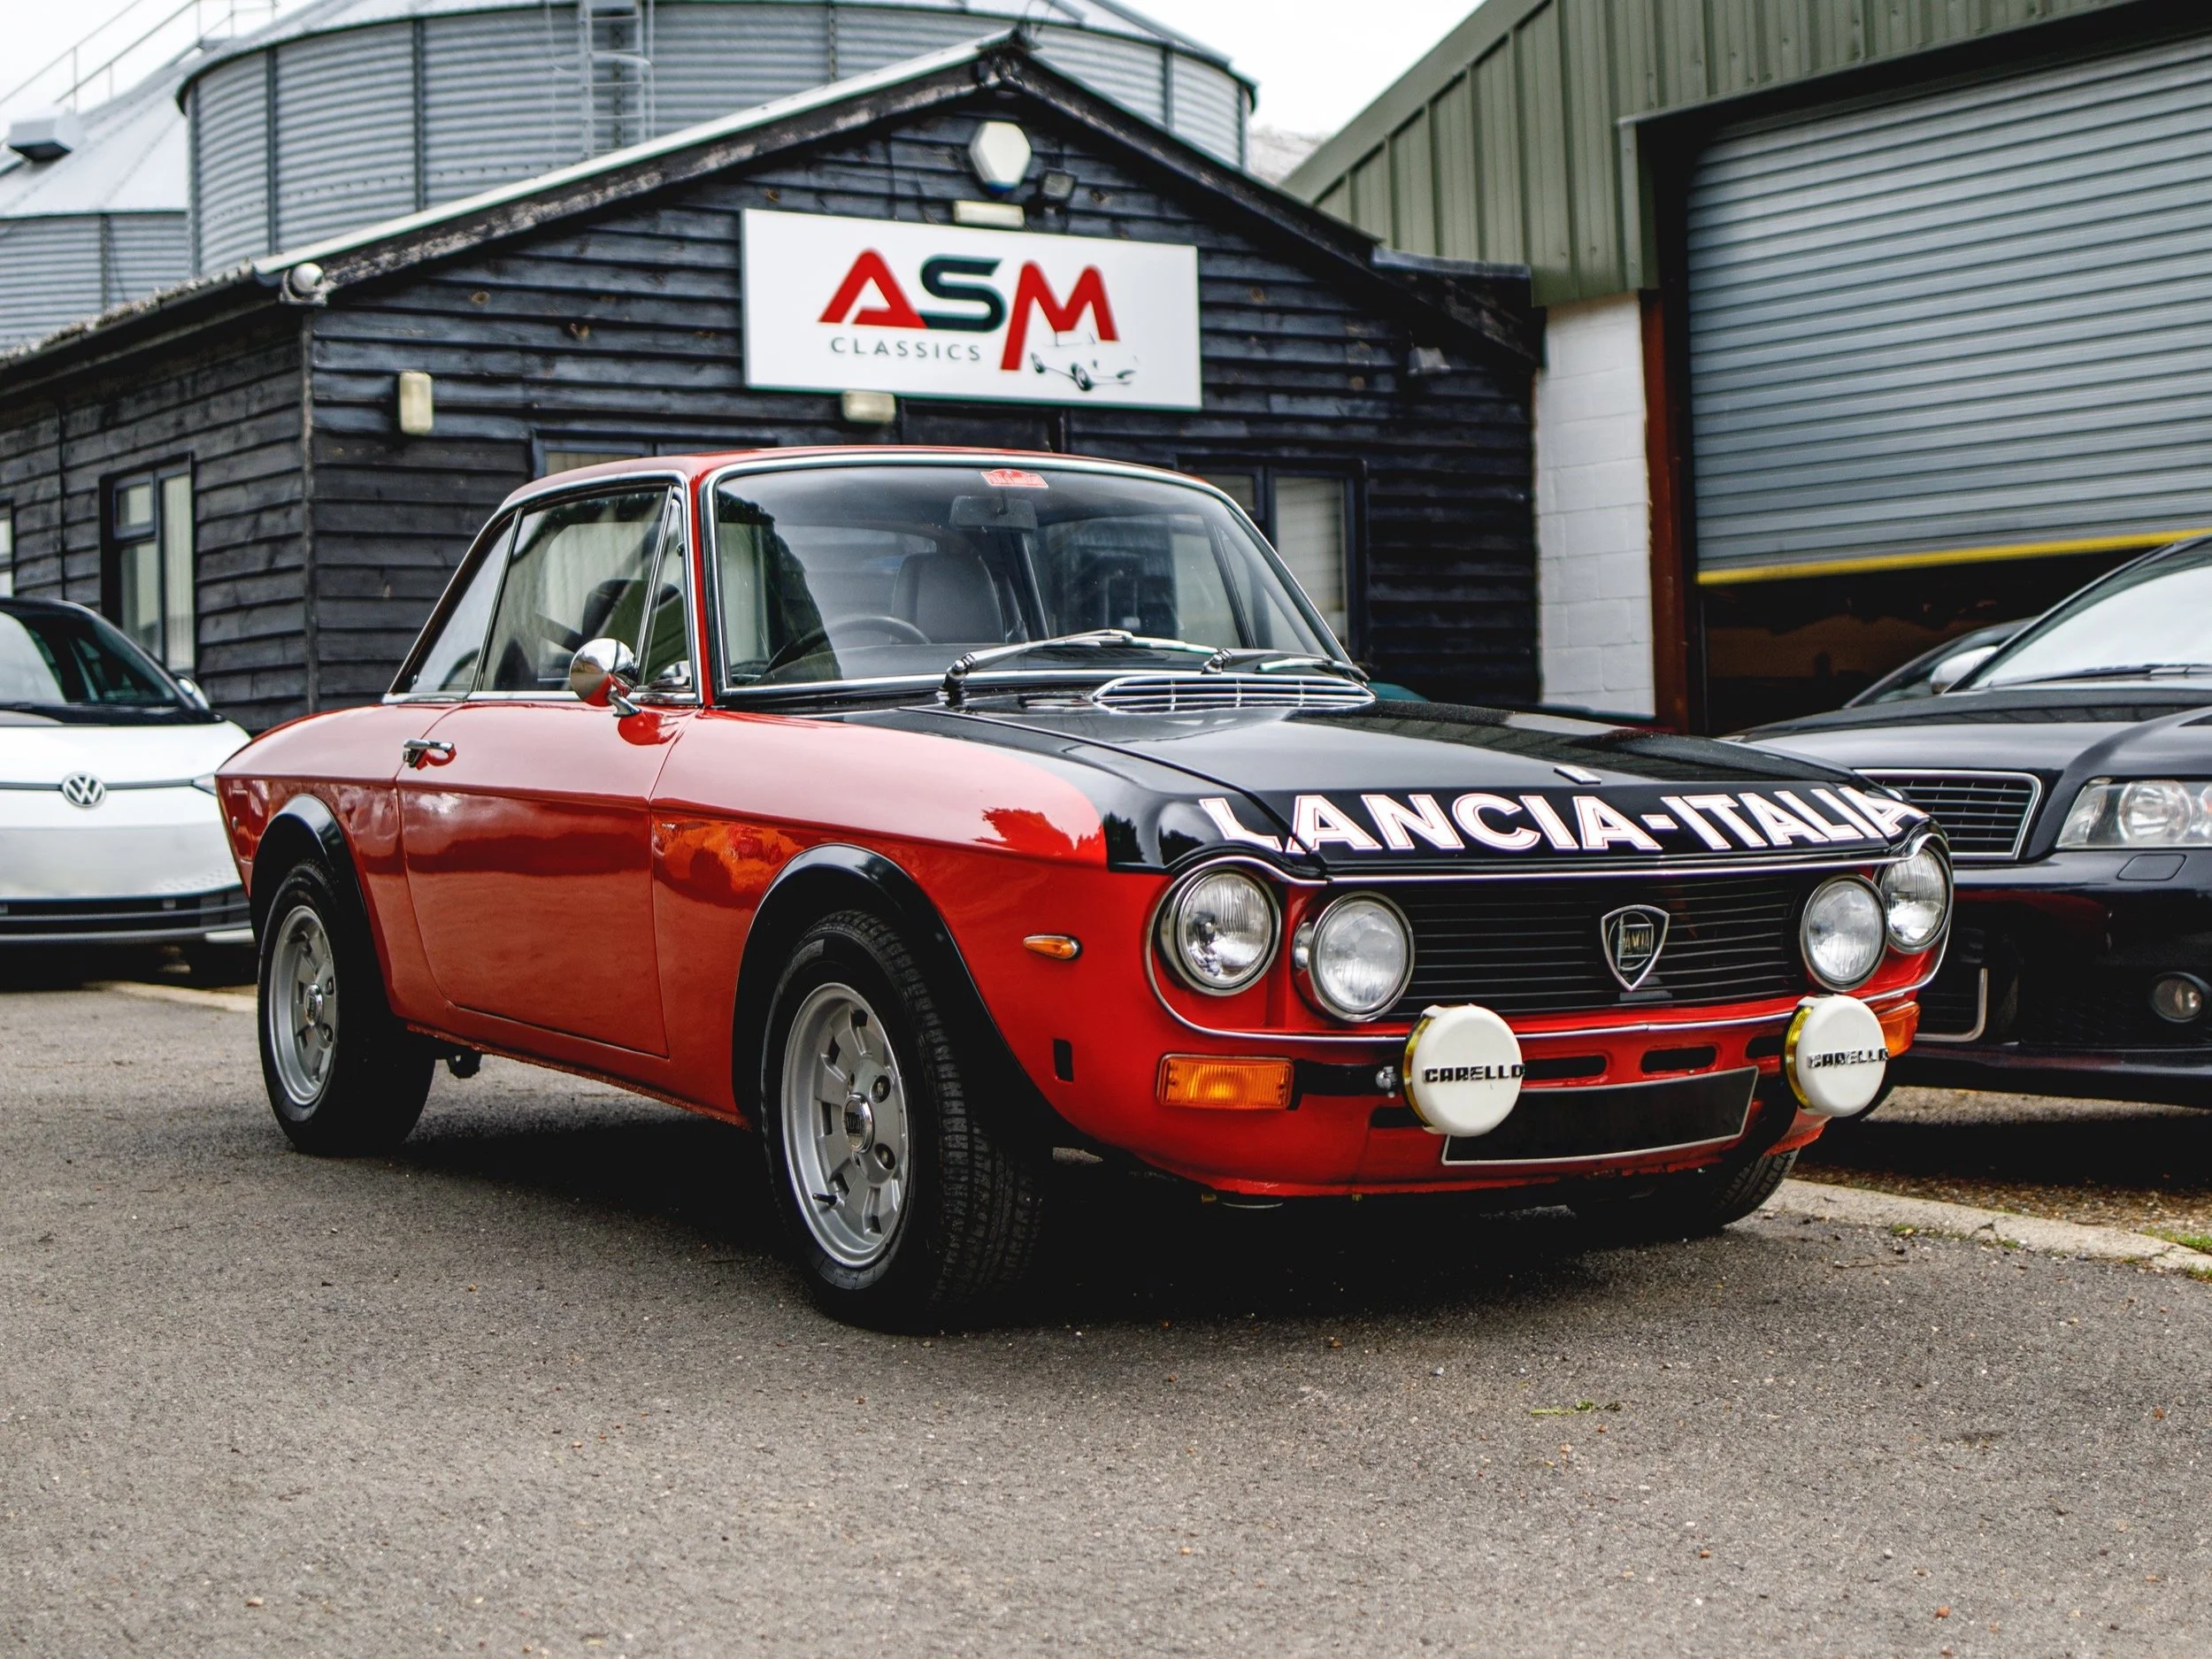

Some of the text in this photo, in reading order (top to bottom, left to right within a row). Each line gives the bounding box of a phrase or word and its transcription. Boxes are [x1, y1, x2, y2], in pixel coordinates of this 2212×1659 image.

[818, 248, 1119, 371] ASM
[830, 336, 981, 362] CLASSICS
[1807, 1048, 1890, 1069] CARELLO
[1423, 1064, 1525, 1083] CARELLO
